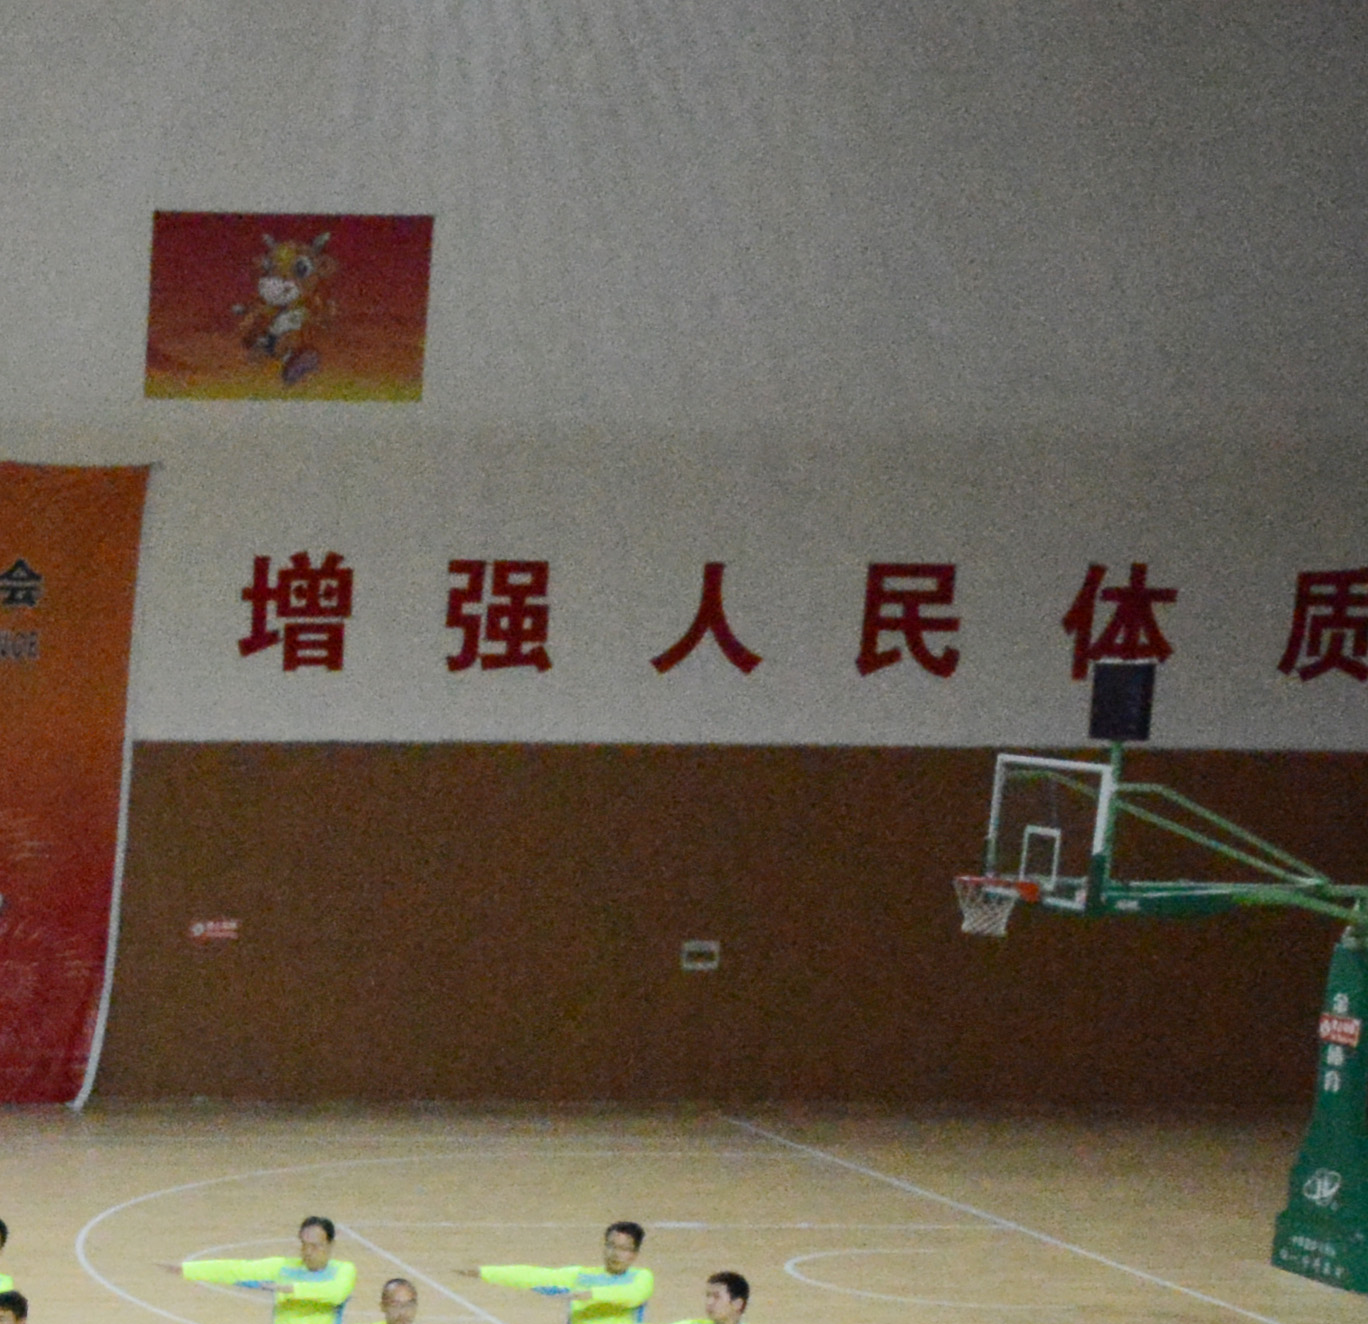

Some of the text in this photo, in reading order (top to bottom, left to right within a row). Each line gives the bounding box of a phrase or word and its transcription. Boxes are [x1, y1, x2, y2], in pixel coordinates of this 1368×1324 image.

[237, 551, 1368, 684] 增强人民体质
